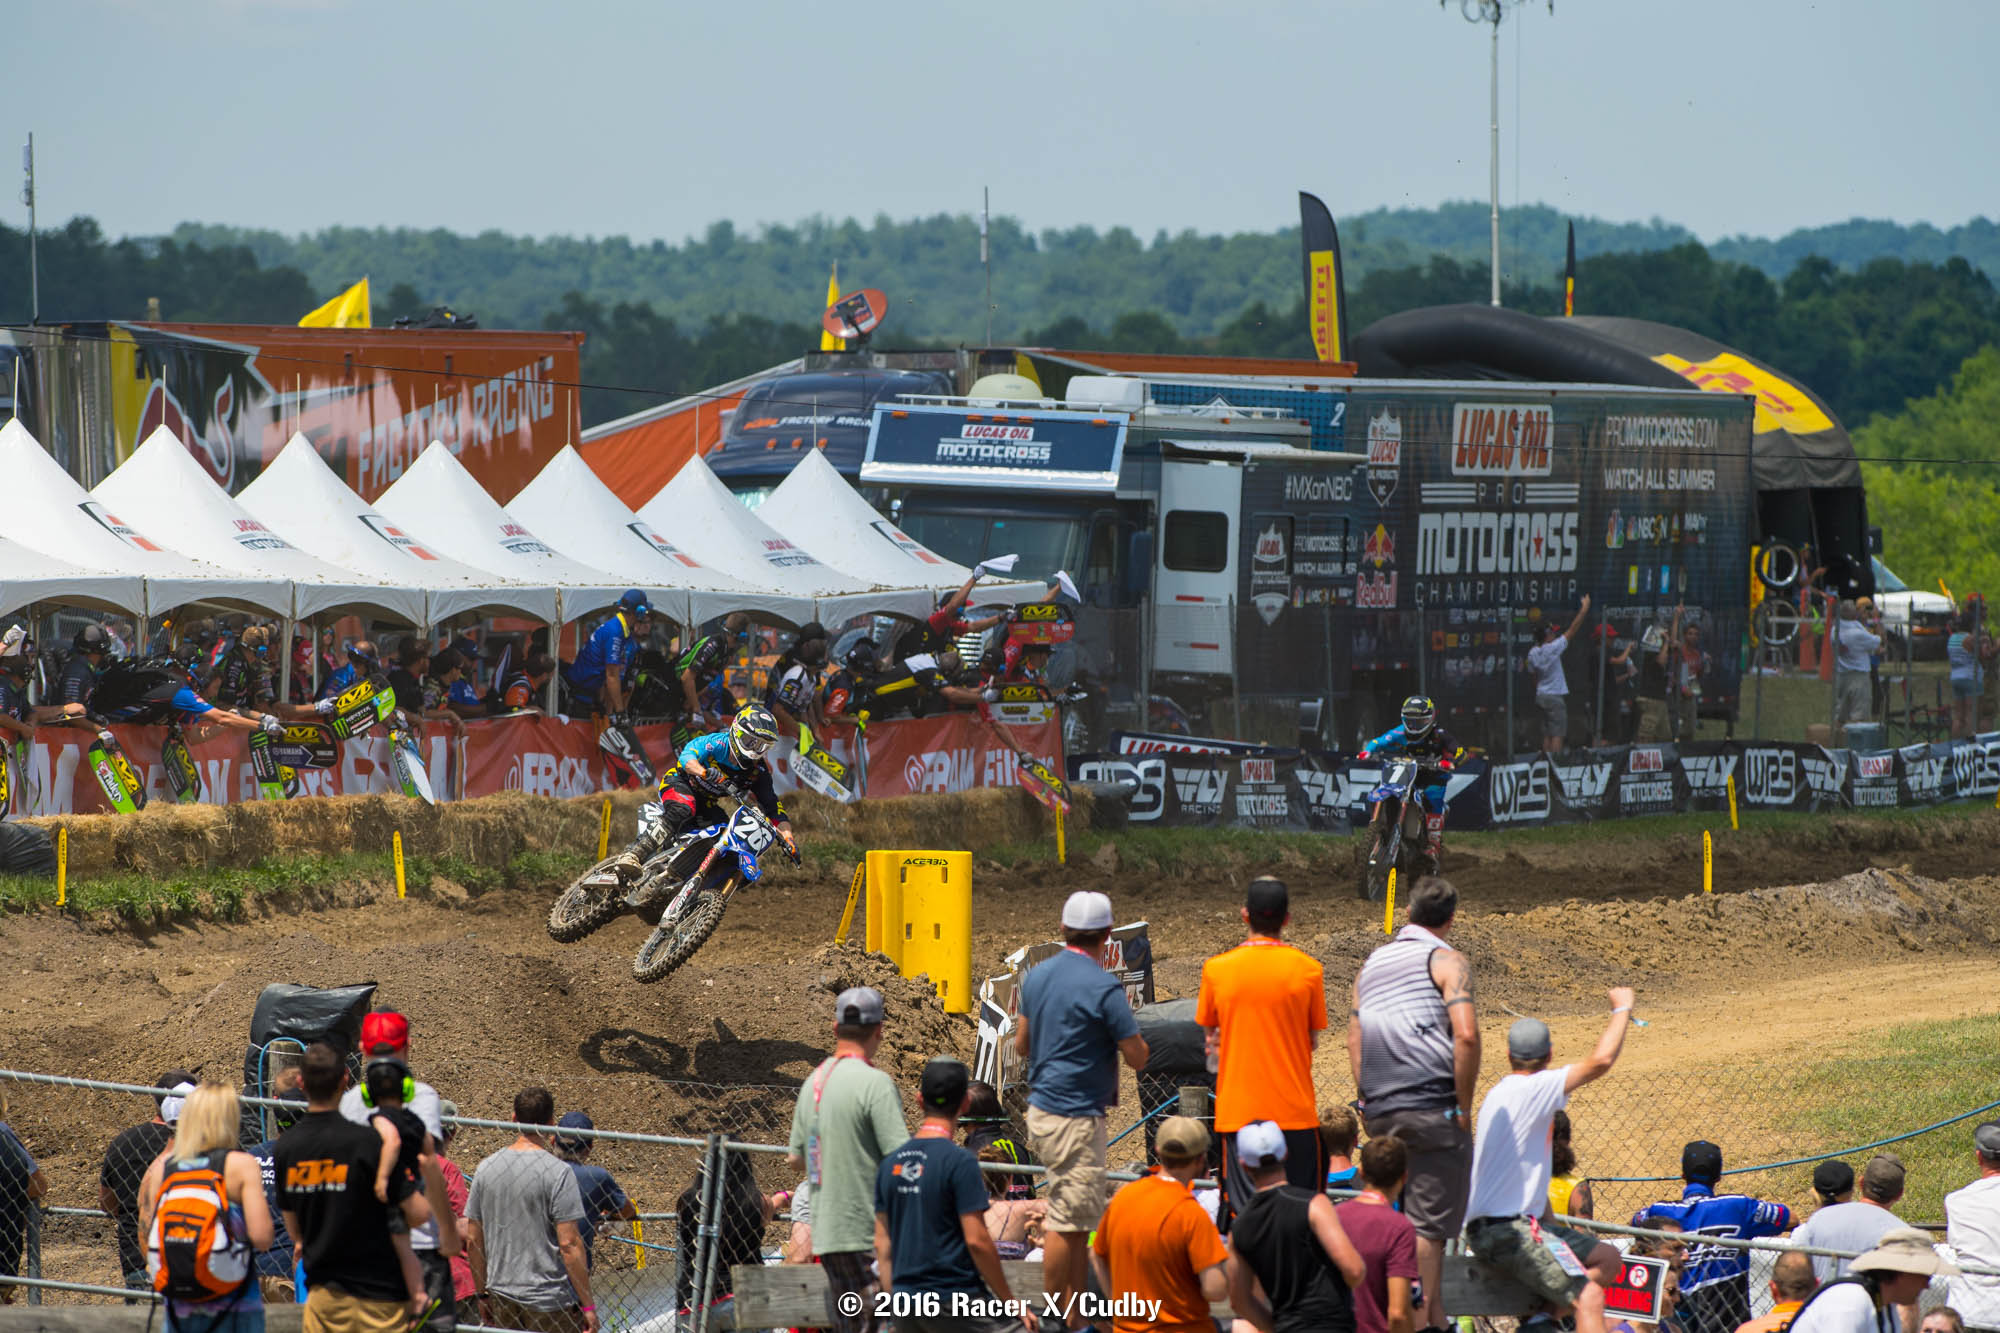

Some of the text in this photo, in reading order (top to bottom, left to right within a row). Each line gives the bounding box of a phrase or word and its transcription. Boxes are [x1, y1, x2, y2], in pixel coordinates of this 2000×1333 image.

[359, 356, 554, 494] FACTORY RACING
[1329, 402, 1346, 427] 2
[964, 426, 1031, 439] LUCAS OIL
[1456, 408, 1549, 470] LUCAS OIL
[1605, 416, 1719, 448] PROMOTOCROSS.COM
[936, 443, 1051, 460] MOTOCROSS
[1369, 440, 1399, 463] LUCAS
[1285, 475, 1353, 501] #MXonNBC
[1478, 482, 1523, 504] PRO
[1604, 468, 1716, 490] WATCH ALL SUMMER
[1416, 512, 1579, 575] MOTOCROSS
[1415, 579, 1577, 603] CHAMPIONSHIP
[912, 748, 975, 793] FRAM
[1172, 768, 1228, 803] FLY
[1388, 764, 1406, 784] 1
[1556, 762, 1613, 799] FLY
[1680, 755, 1739, 788] FLY
[1745, 748, 1796, 805] WPS
[1905, 756, 1948, 792] FLY
[1295, 769, 1352, 808] FLY
[1490, 760, 1550, 823] WPS
[1620, 780, 1673, 805] MOTOCROSS
[1181, 804, 1222, 815] RACING
[733, 815, 773, 852] 26
[903, 858, 949, 866] ACERBIS
[287, 1158, 349, 1186] KTM
